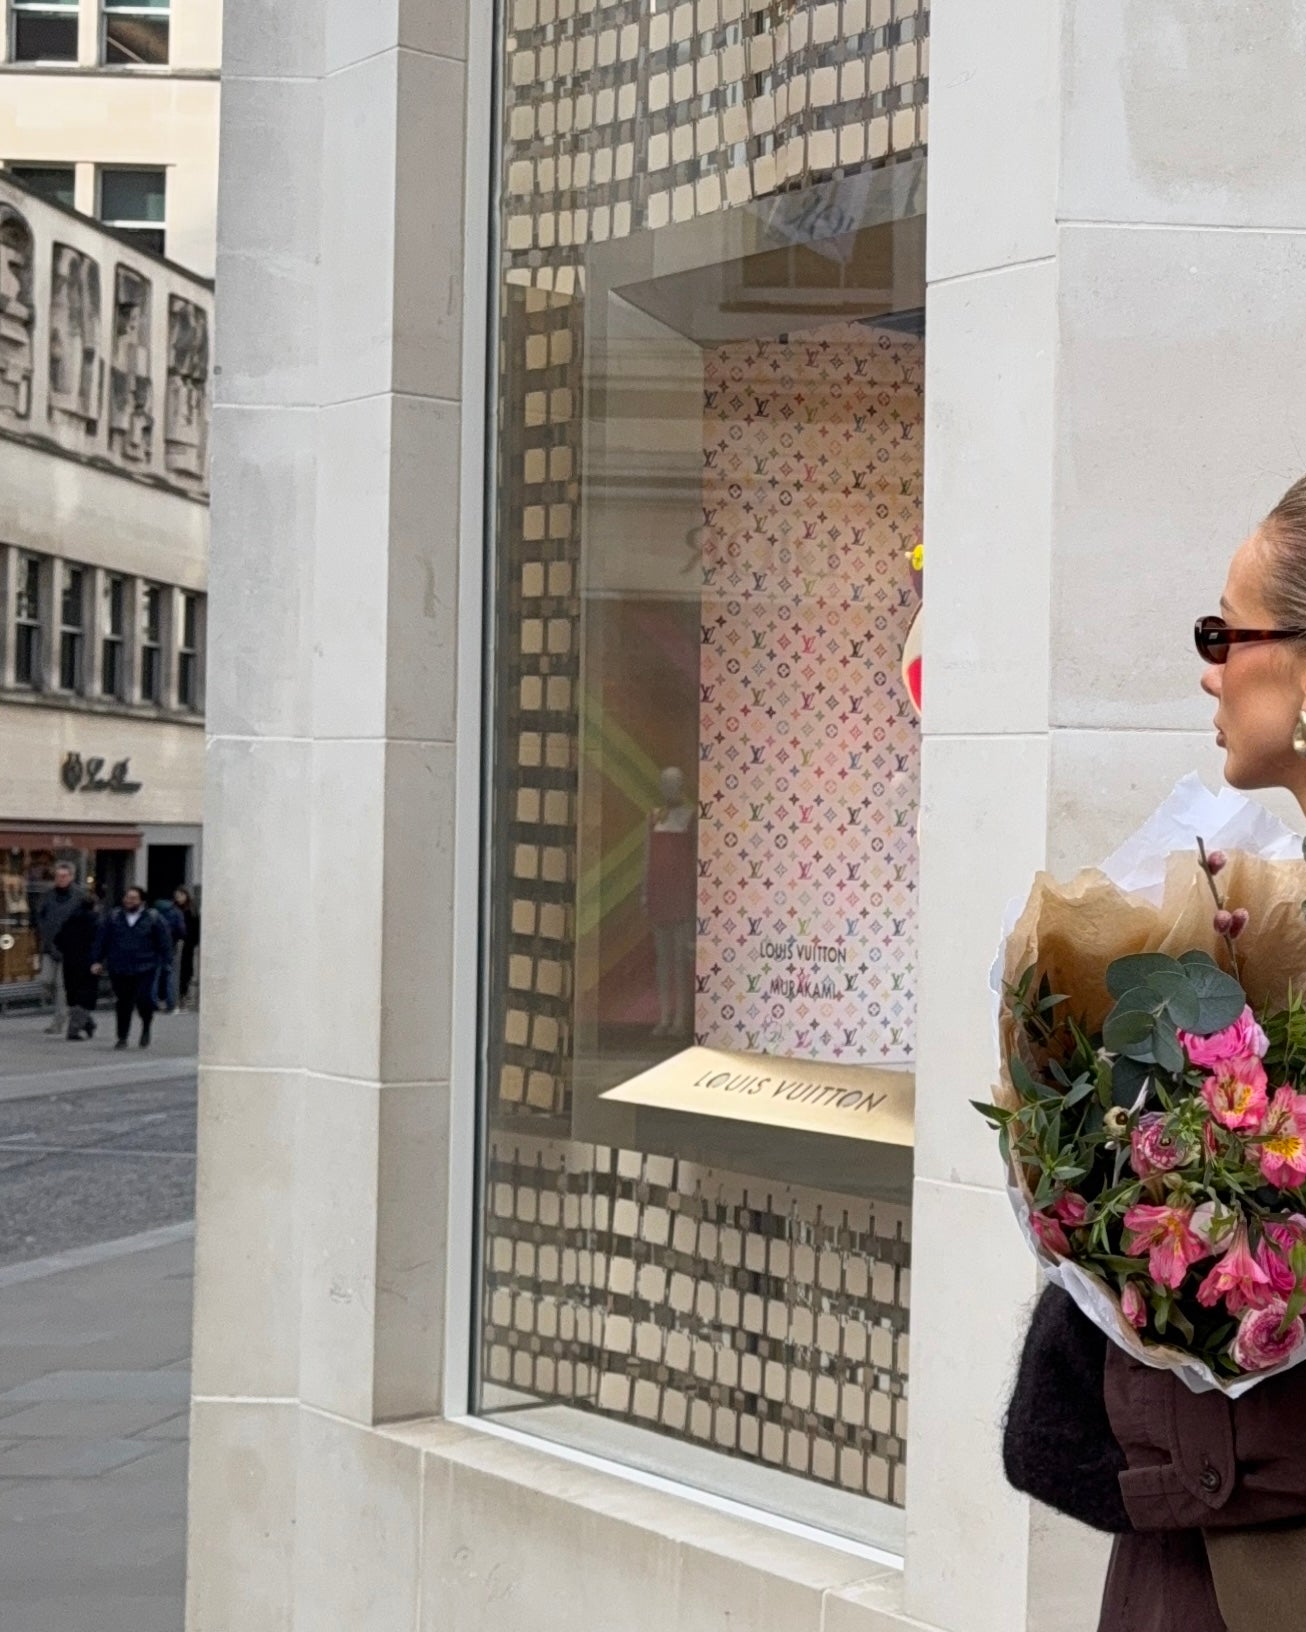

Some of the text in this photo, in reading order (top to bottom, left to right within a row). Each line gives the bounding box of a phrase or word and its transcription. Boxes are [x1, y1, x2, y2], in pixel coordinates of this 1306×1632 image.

[760, 942, 847, 963] LOUIS VUITTON
[770, 979, 836, 1000] MURAKAMI
[693, 1070, 888, 1112] LOUIS VUITTON
